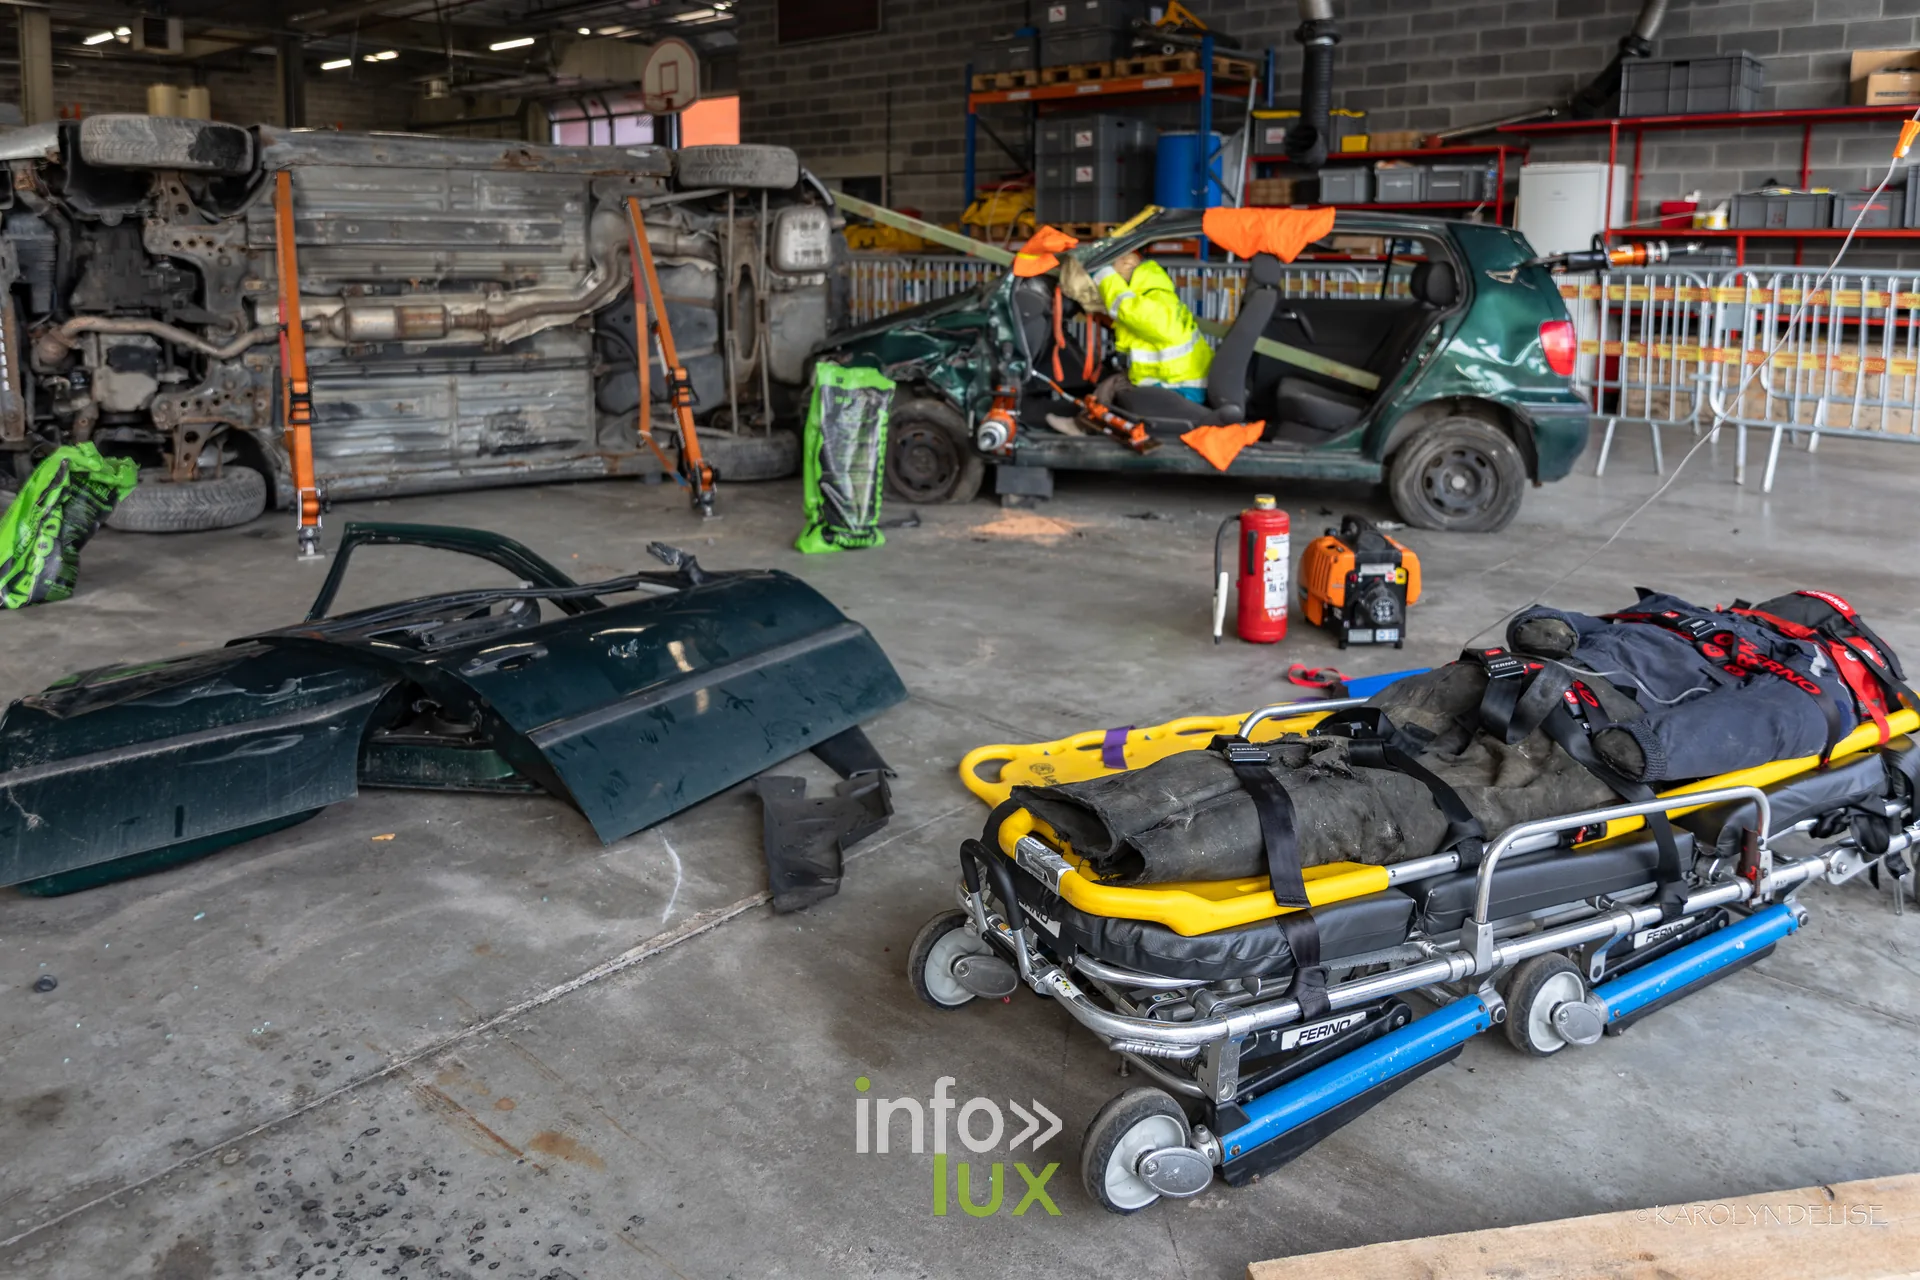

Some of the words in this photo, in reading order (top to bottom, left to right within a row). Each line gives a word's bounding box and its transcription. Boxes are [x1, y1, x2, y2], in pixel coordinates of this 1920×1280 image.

[1490, 660, 1518, 670] FERNO
[1755, 653, 1822, 695] ERNO
[1298, 1018, 1352, 1042] FERNO
